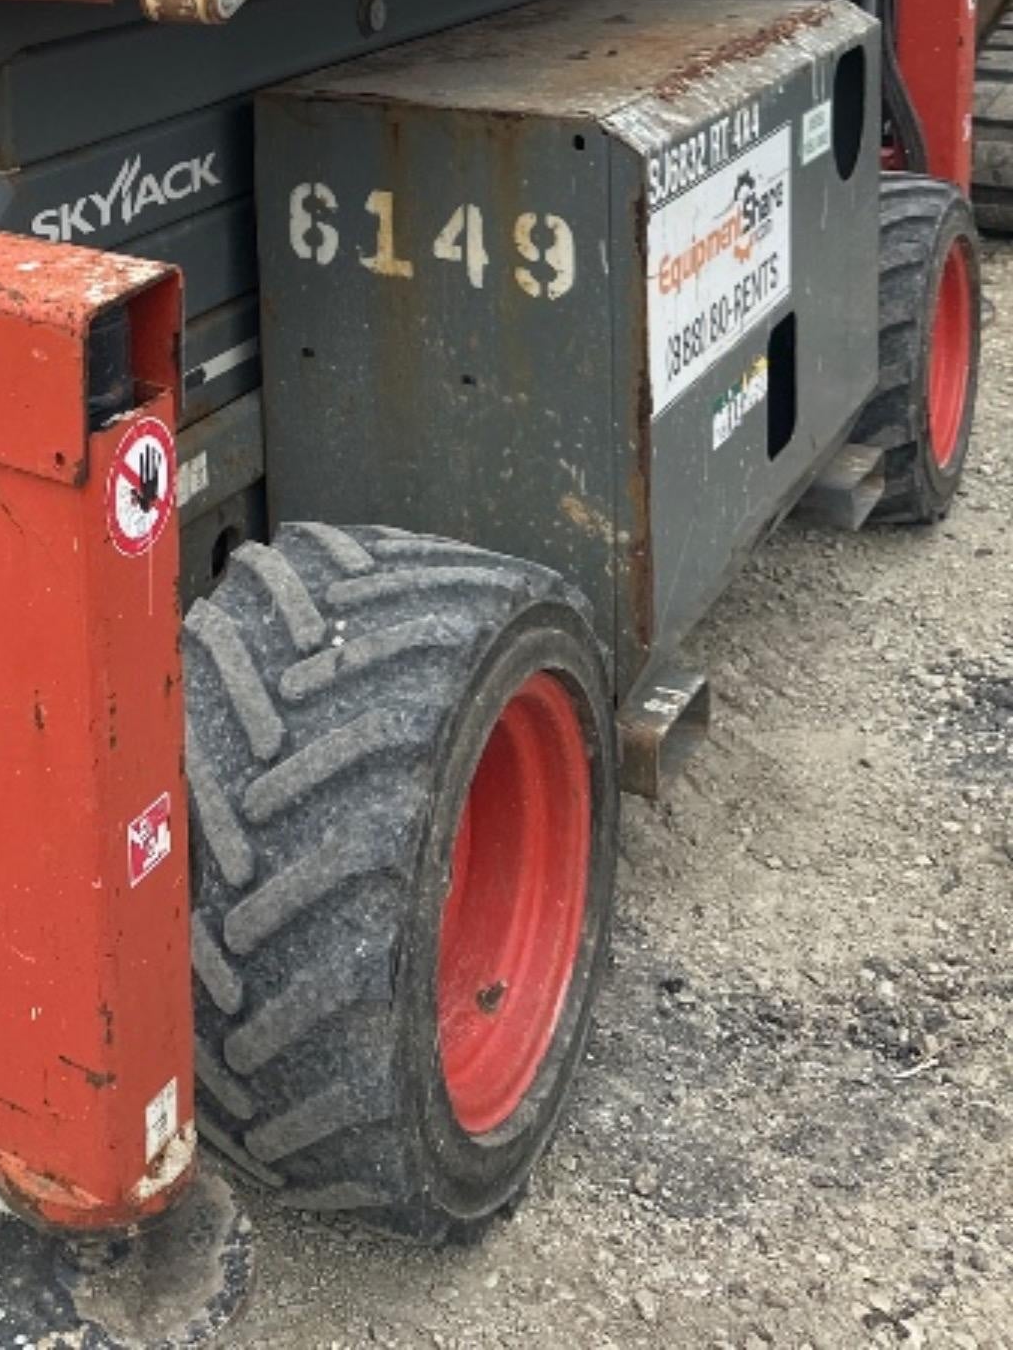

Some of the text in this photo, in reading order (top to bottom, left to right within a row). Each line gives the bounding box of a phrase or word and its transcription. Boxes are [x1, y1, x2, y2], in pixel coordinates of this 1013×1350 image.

[709, 115, 730, 169] RT
[31, 152, 221, 243] SKYJACK
[289, 182, 576, 301] 6149
